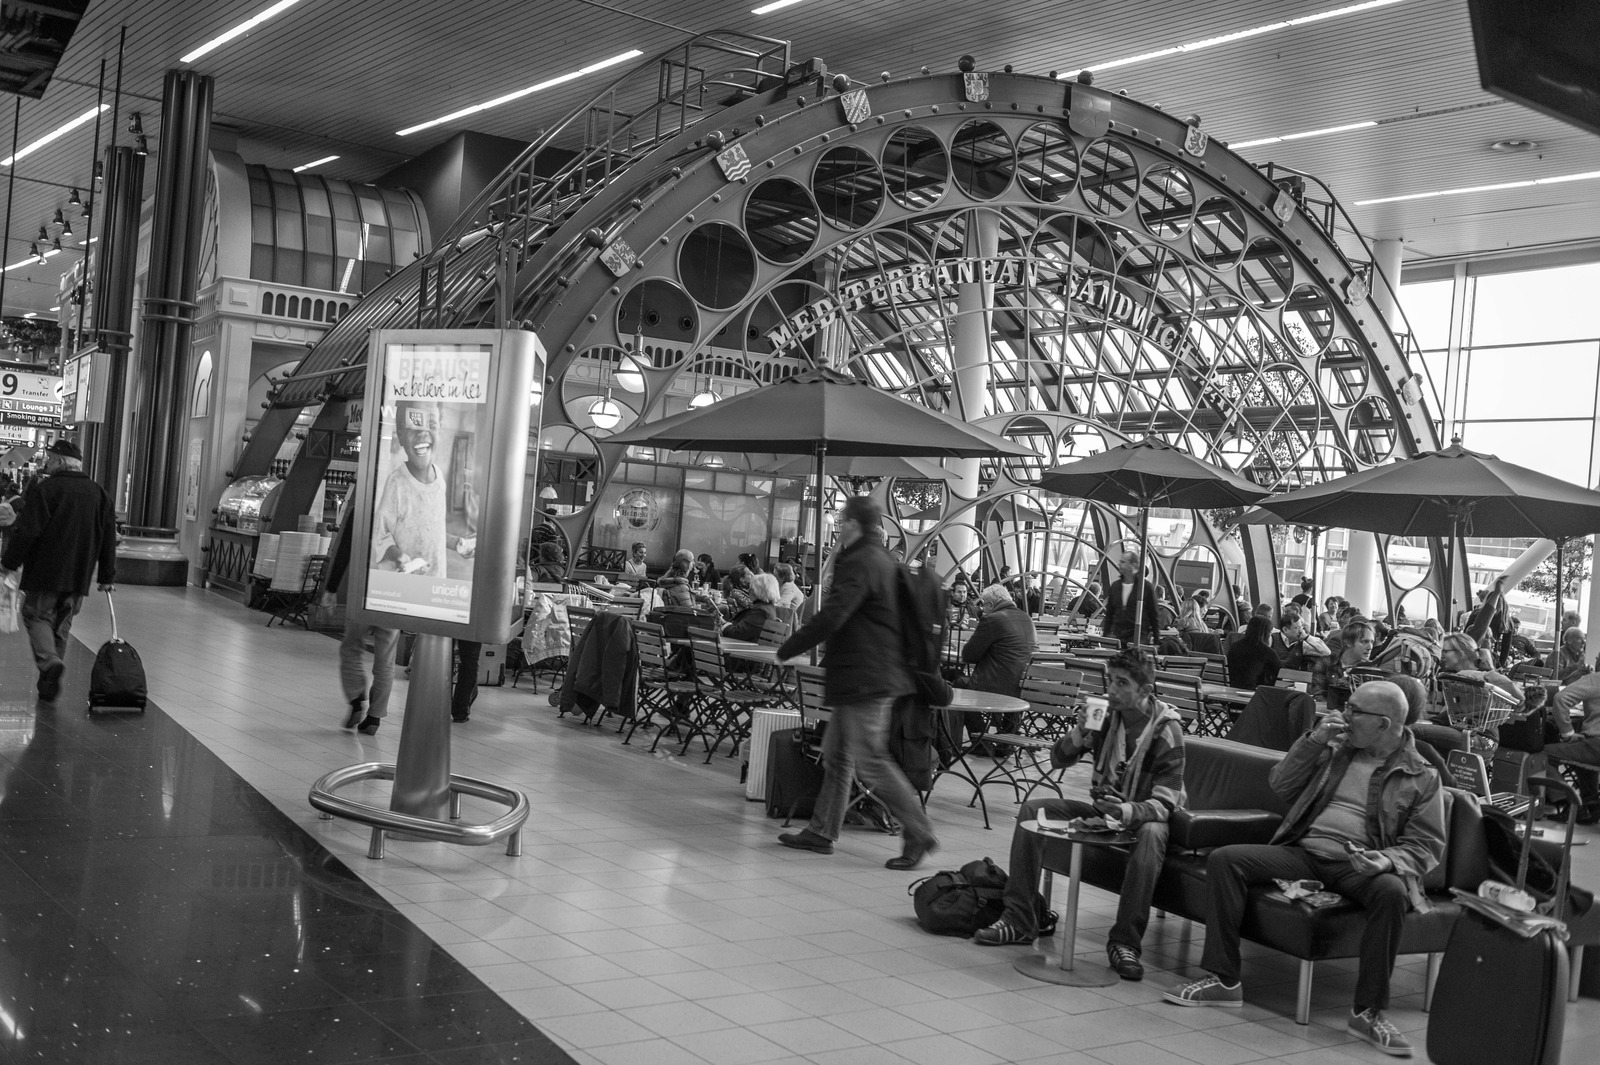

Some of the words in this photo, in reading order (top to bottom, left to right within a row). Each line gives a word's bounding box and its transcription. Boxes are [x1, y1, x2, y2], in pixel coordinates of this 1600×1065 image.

[399, 358, 480, 382] BECAUSE
[2, 373, 18, 396] 9
[410, 374, 446, 398] believe
[22, 389, 49, 397] Transfer
[22, 403, 48, 413] Lounge
[6, 412, 36, 422] Smoking
[37, 415, 53, 423] area
[1330, 550, 1343, 559] D4
[432, 584, 459, 597] unicef
